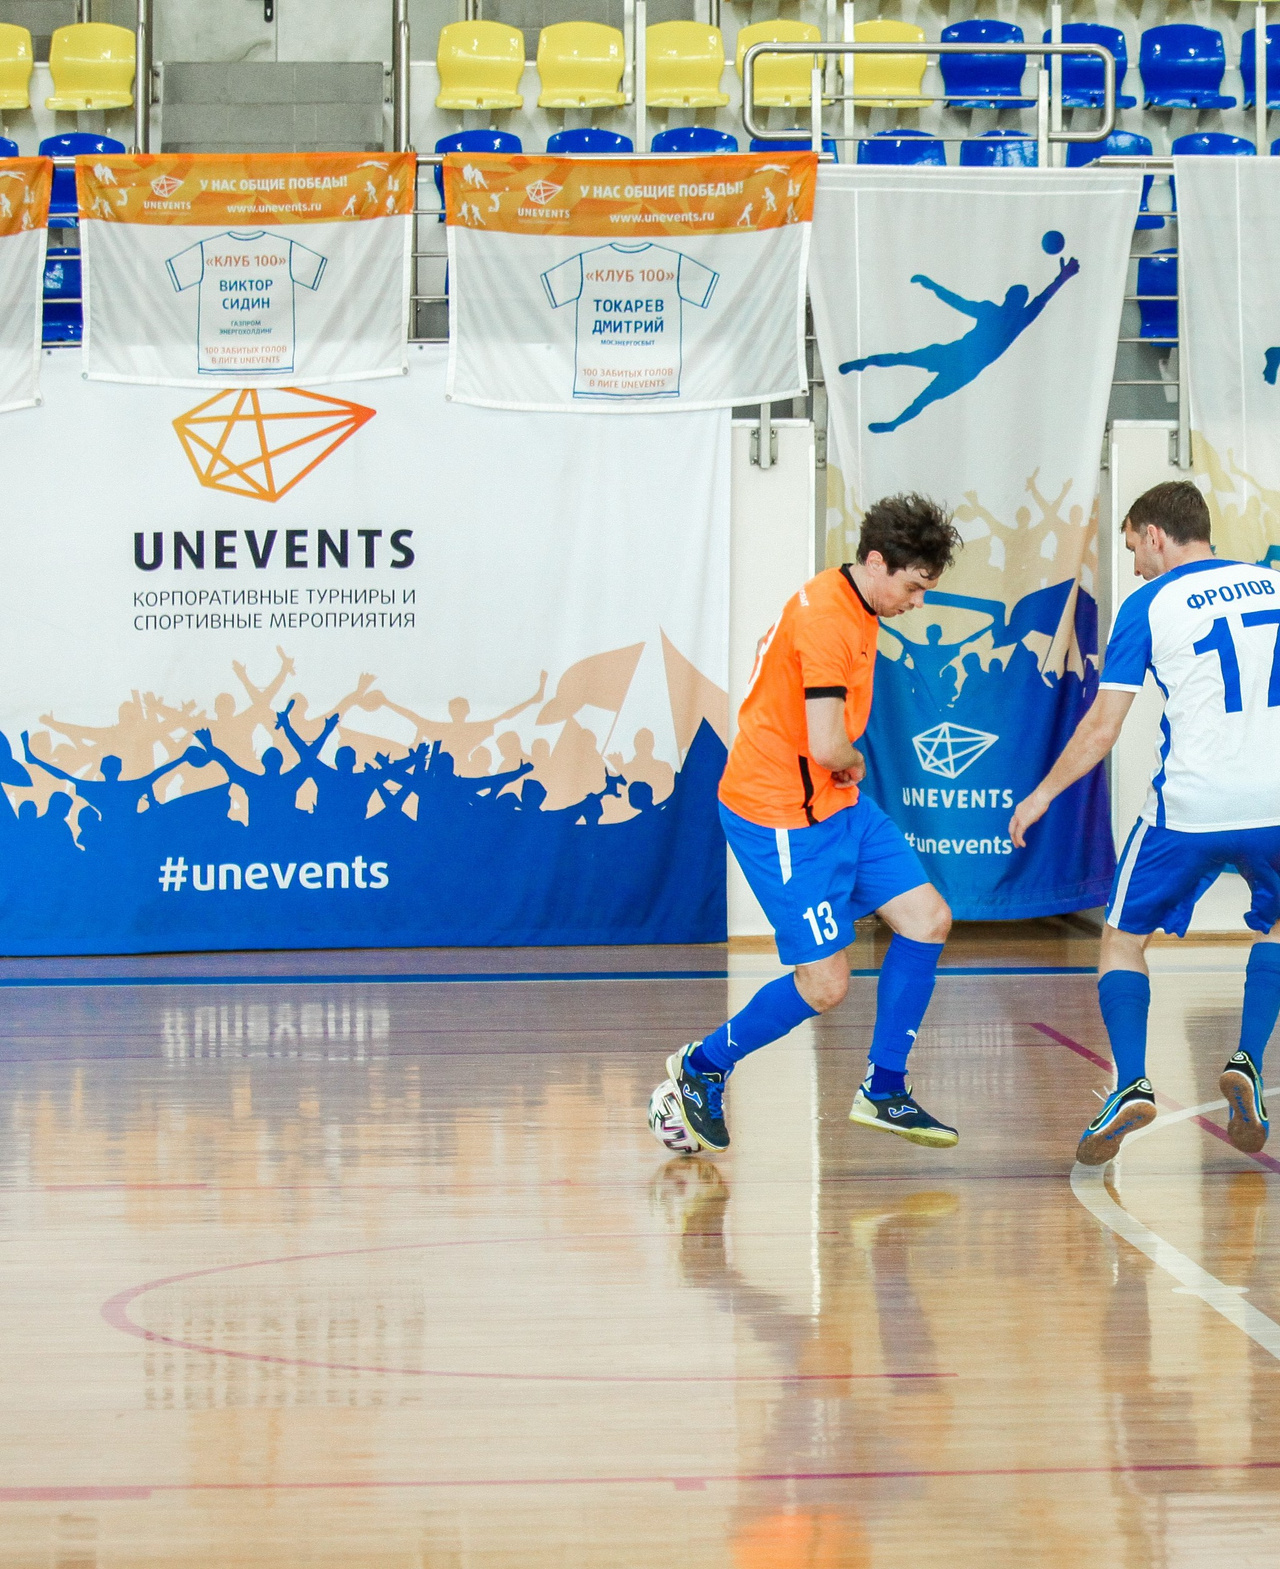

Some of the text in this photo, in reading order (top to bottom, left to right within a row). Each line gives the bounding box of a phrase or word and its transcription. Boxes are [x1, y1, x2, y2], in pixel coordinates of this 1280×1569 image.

[200, 176, 348, 192] У НАС ОБЩИЕ ПОБЕДЫ!
[580, 181, 744, 200] У НАС ОБЩИЕ ПОБЕДЫ!
[144, 201, 191, 210] UNEVENTS
[227, 202, 322, 213] www.unevents.ru
[517, 207, 570, 218] UNEVENTS
[609, 211, 715, 223] www.unevents.ru
[206, 255, 286, 267] «КЛУБ 100»
[586, 269, 675, 282] «КЛУБ 100»
[219, 279, 273, 292] ВИКТОР
[222, 297, 270, 311] СИДИН
[593, 299, 664, 313] ТОКАРЕВ
[592, 316, 664, 335] ДМИТРИЙ
[205, 345, 287, 354] 100 ЗАБИТЫХ ГОЛОВ
[240, 356, 280, 364] UNEVENTS
[583, 368, 674, 378] 100 ЗАБИТЫХ ГОЛОВ
[597, 380, 619, 388] ЛИГЕ
[621, 380, 666, 388] UNEVENTS
[133, 529, 416, 572] UNEVENTS
[133, 588, 416, 607] КОРПОРАТИВНЫЕ ТУРНИРЫ И
[1186, 578, 1276, 610] ФРОЛОВ
[133, 612, 416, 631] СПОРТИВНЫЕ МЕРОПРИЯТИЯ
[902, 787, 1014, 809] UNEVENTS
[158, 855, 389, 892] #unevents
[803, 900, 839, 946] 13
